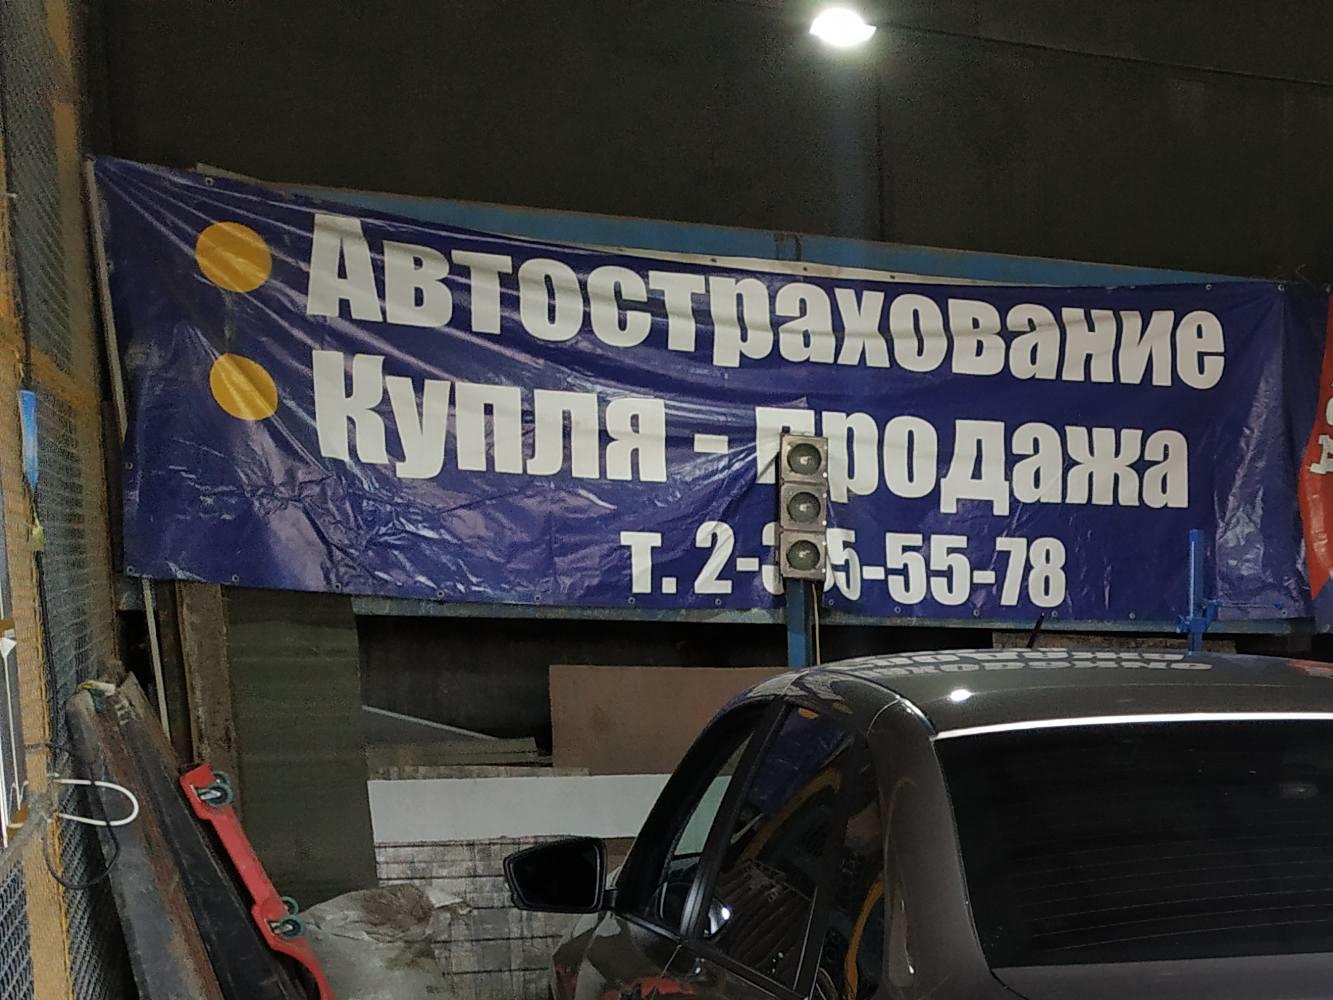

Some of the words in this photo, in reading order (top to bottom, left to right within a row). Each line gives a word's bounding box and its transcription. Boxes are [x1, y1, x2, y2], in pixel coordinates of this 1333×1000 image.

[307, 213, 1226, 390] Автострахование
[312, 350, 667, 480] Купля
[754, 406, 1190, 516] продажа
